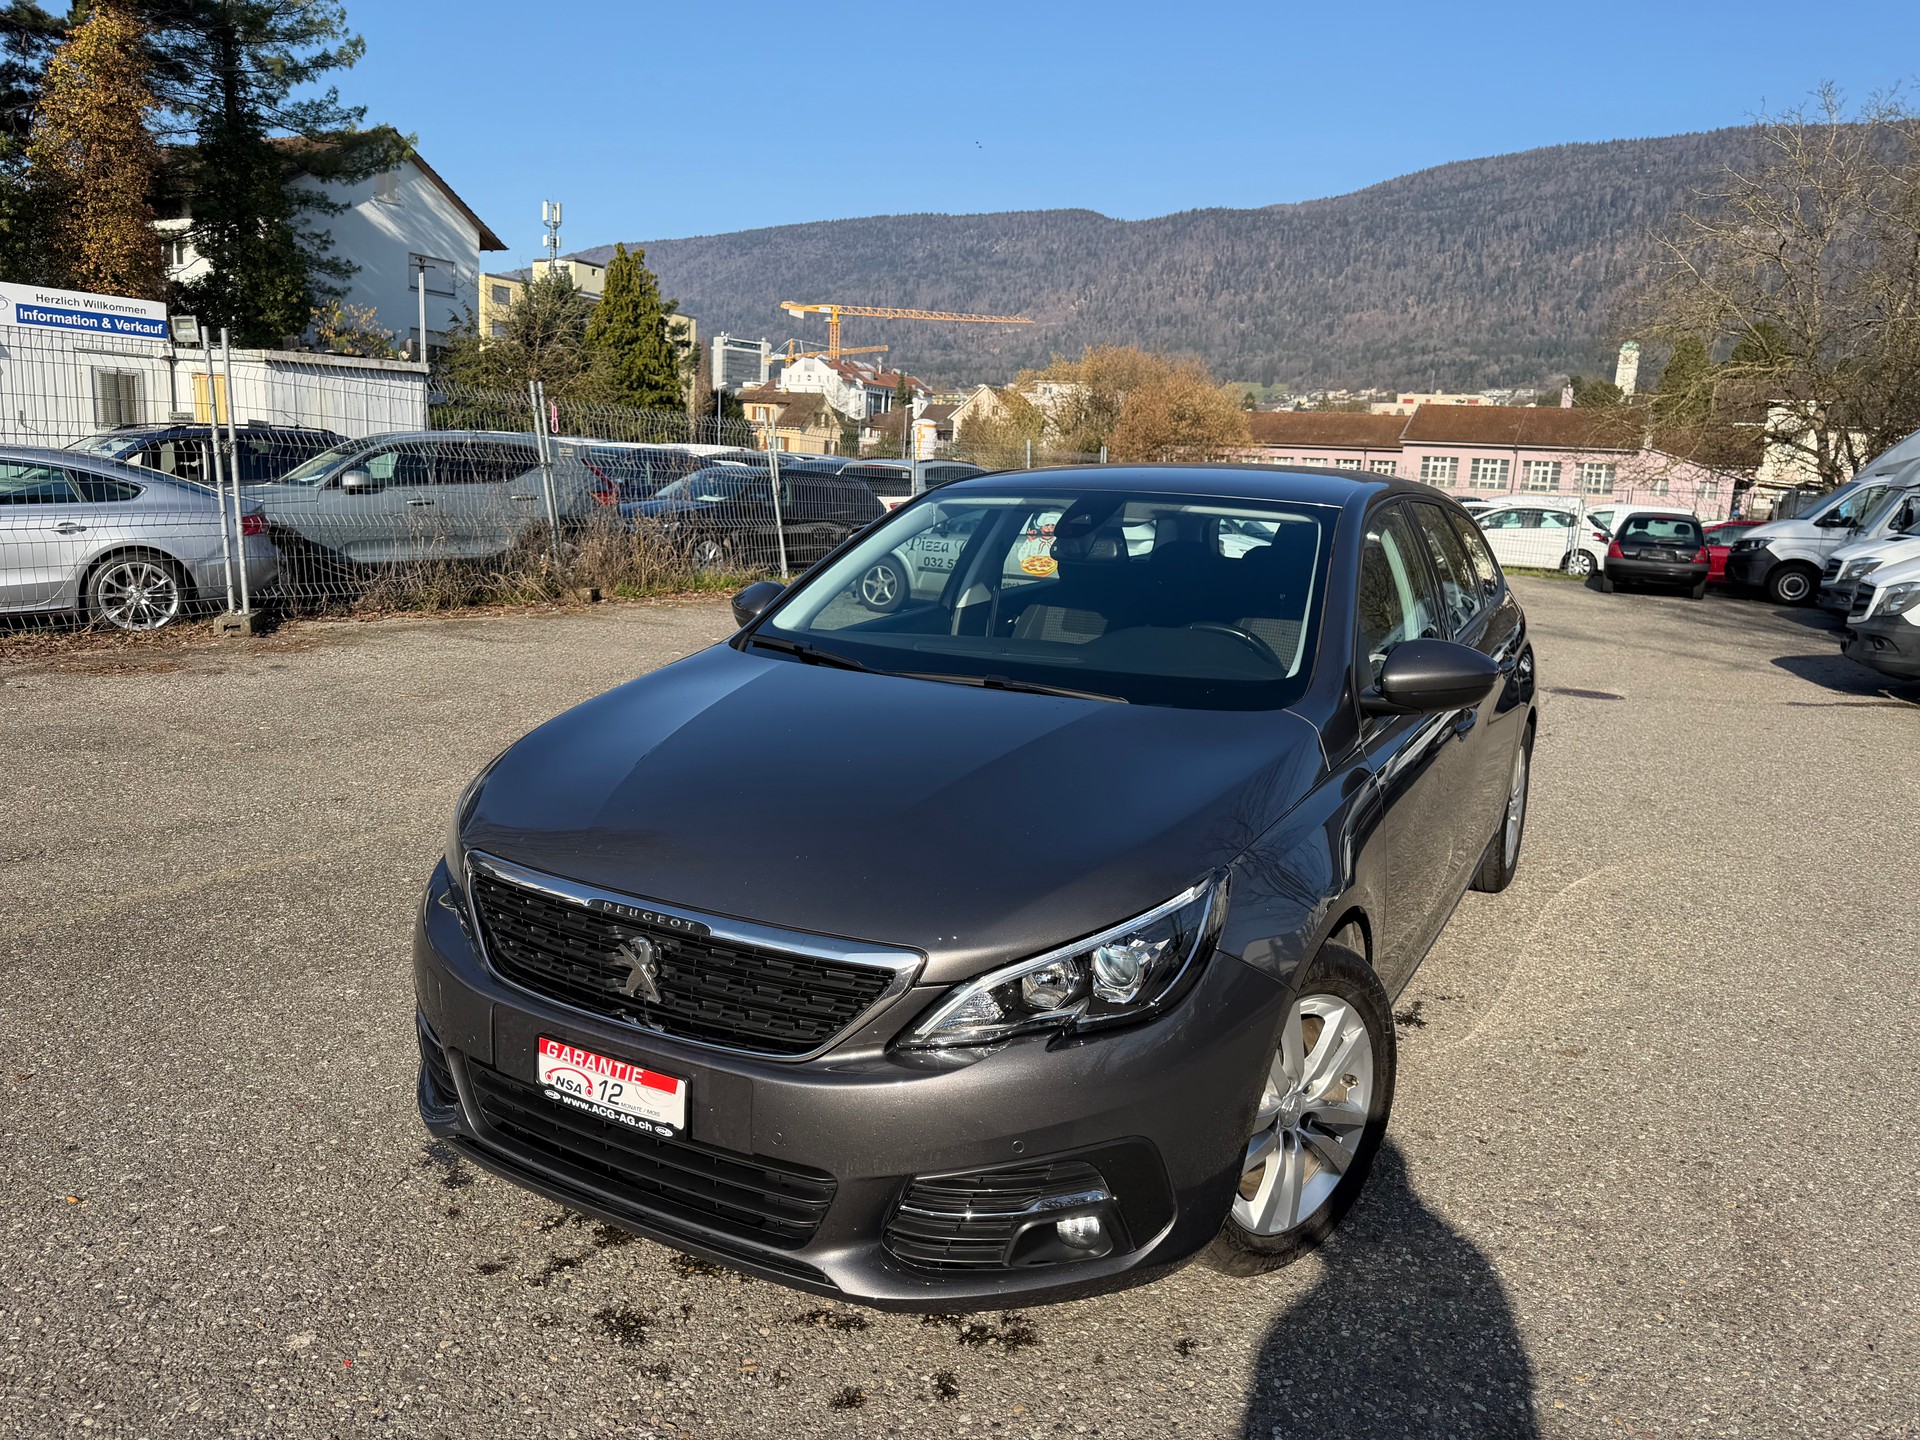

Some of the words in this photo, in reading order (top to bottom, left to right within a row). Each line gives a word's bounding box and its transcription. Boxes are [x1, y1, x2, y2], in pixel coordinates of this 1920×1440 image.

[35, 293, 80, 307] Herzlich
[83, 299, 147, 315] Willkommen
[19, 308, 98, 328] Information
[101, 317, 112, 329] &
[114, 318, 163, 335] Verkauf
[906, 536, 949, 553] Pizza
[923, 556, 944, 568] 032
[603, 901, 695, 932] PEUGEOT
[546, 1041, 645, 1085] GARANTIE
[555, 1075, 582, 1095] NSA
[598, 1079, 623, 1106] 12
[562, 1095, 653, 1132] www.ACG-AG.ch
